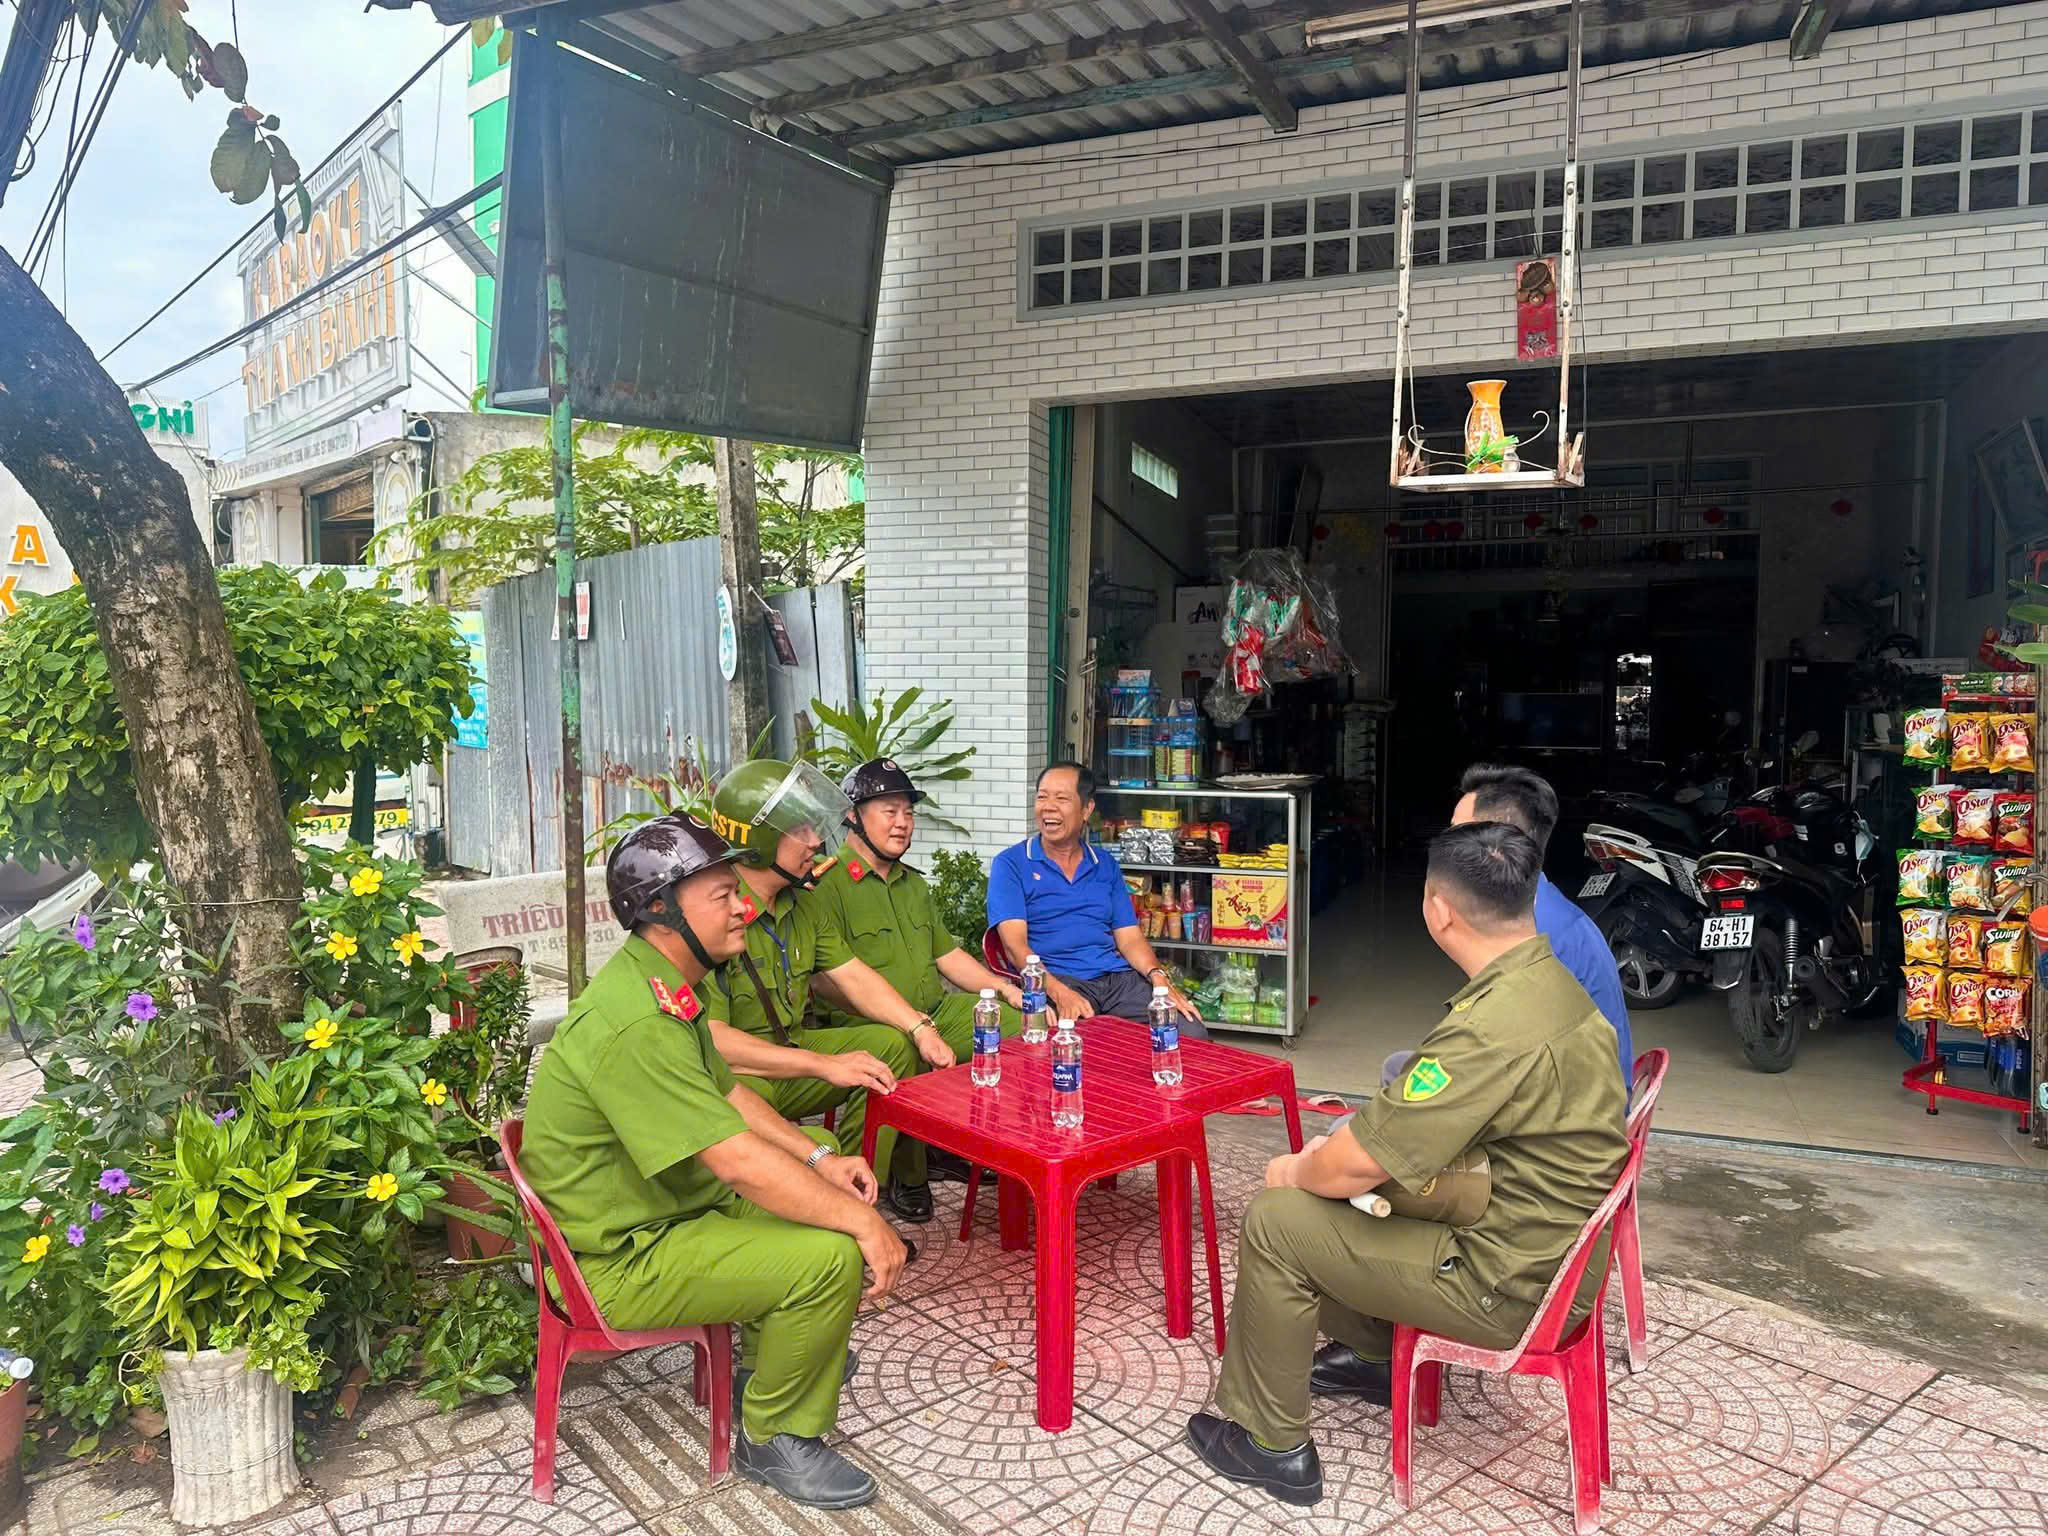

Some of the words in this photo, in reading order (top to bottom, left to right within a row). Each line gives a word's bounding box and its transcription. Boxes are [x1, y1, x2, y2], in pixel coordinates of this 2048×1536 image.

[712, 808, 752, 845] CSTT
[1709, 917, 1747, 933] 64-H1
[1703, 932, 1749, 947] 381.57
